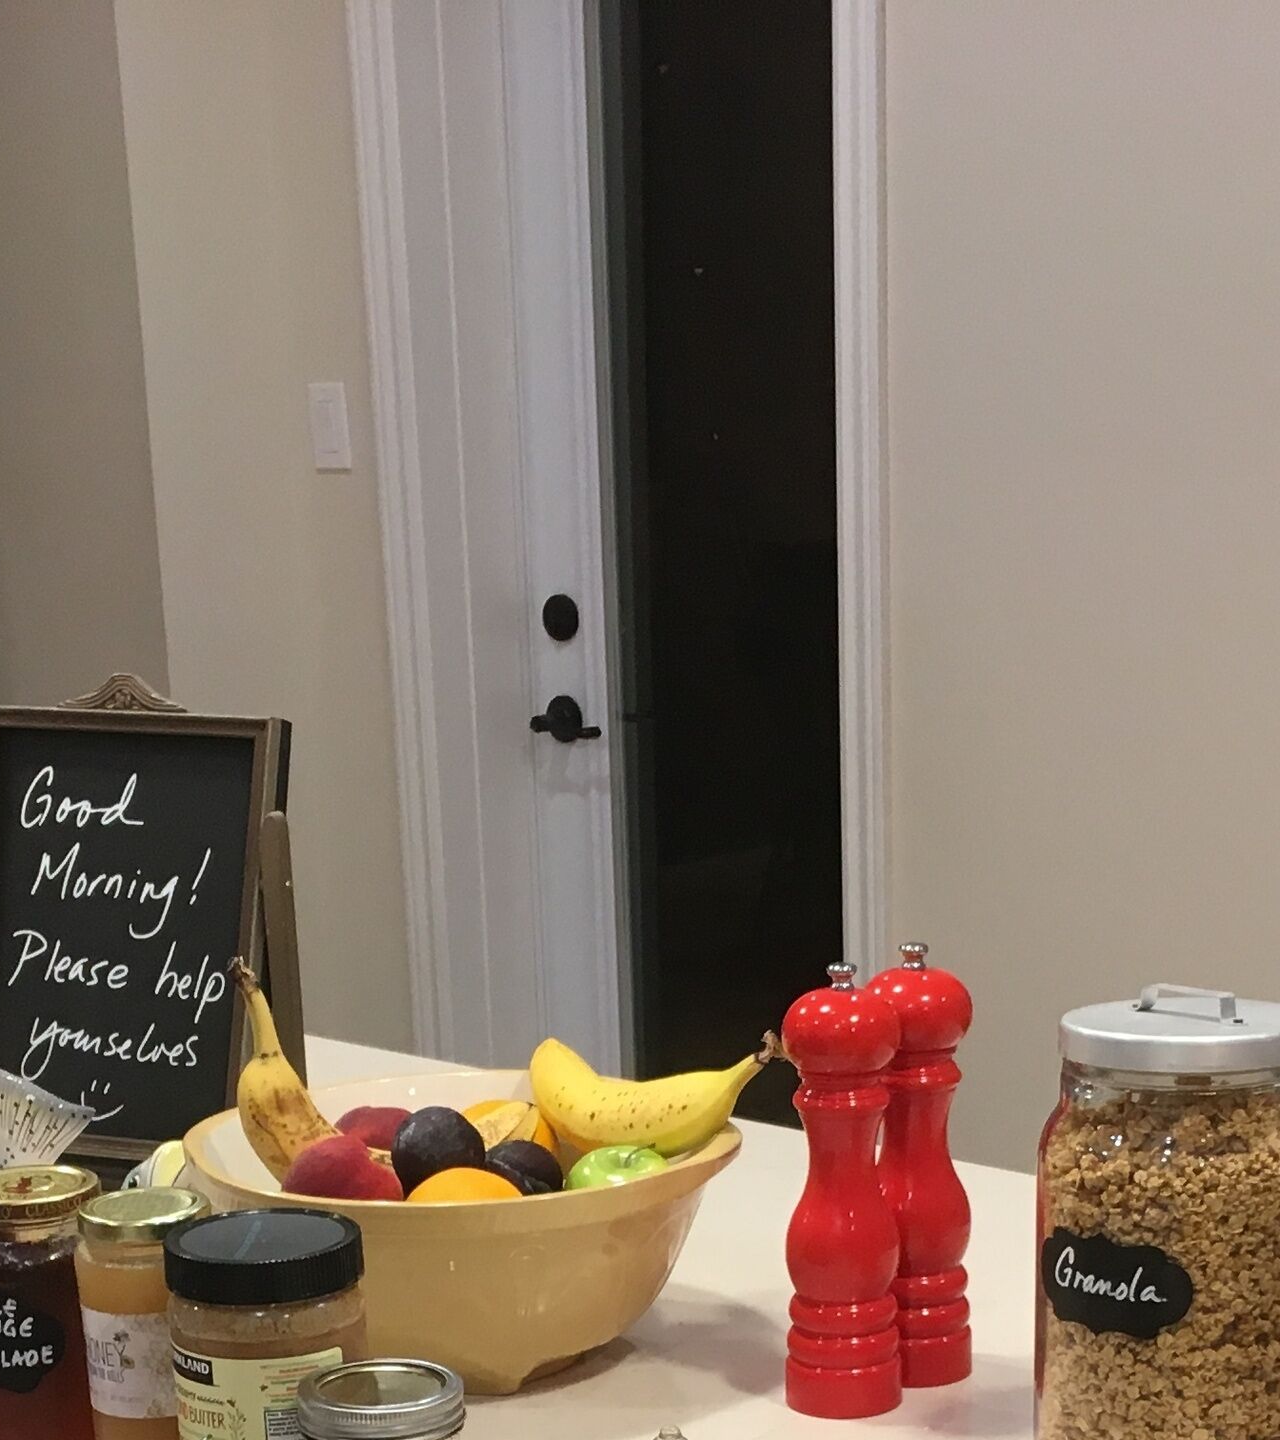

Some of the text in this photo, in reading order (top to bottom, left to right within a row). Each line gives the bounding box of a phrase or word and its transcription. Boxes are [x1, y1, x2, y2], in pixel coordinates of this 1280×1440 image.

[21, 765, 144, 829] Good
[30, 842, 211, 940] Morning!
[8, 929, 225, 1024] Please help
[20, 1016, 200, 1081] yourselves
[1053, 1245, 1168, 1303] Granola
[189, 1406, 227, 1431] BUTTER
